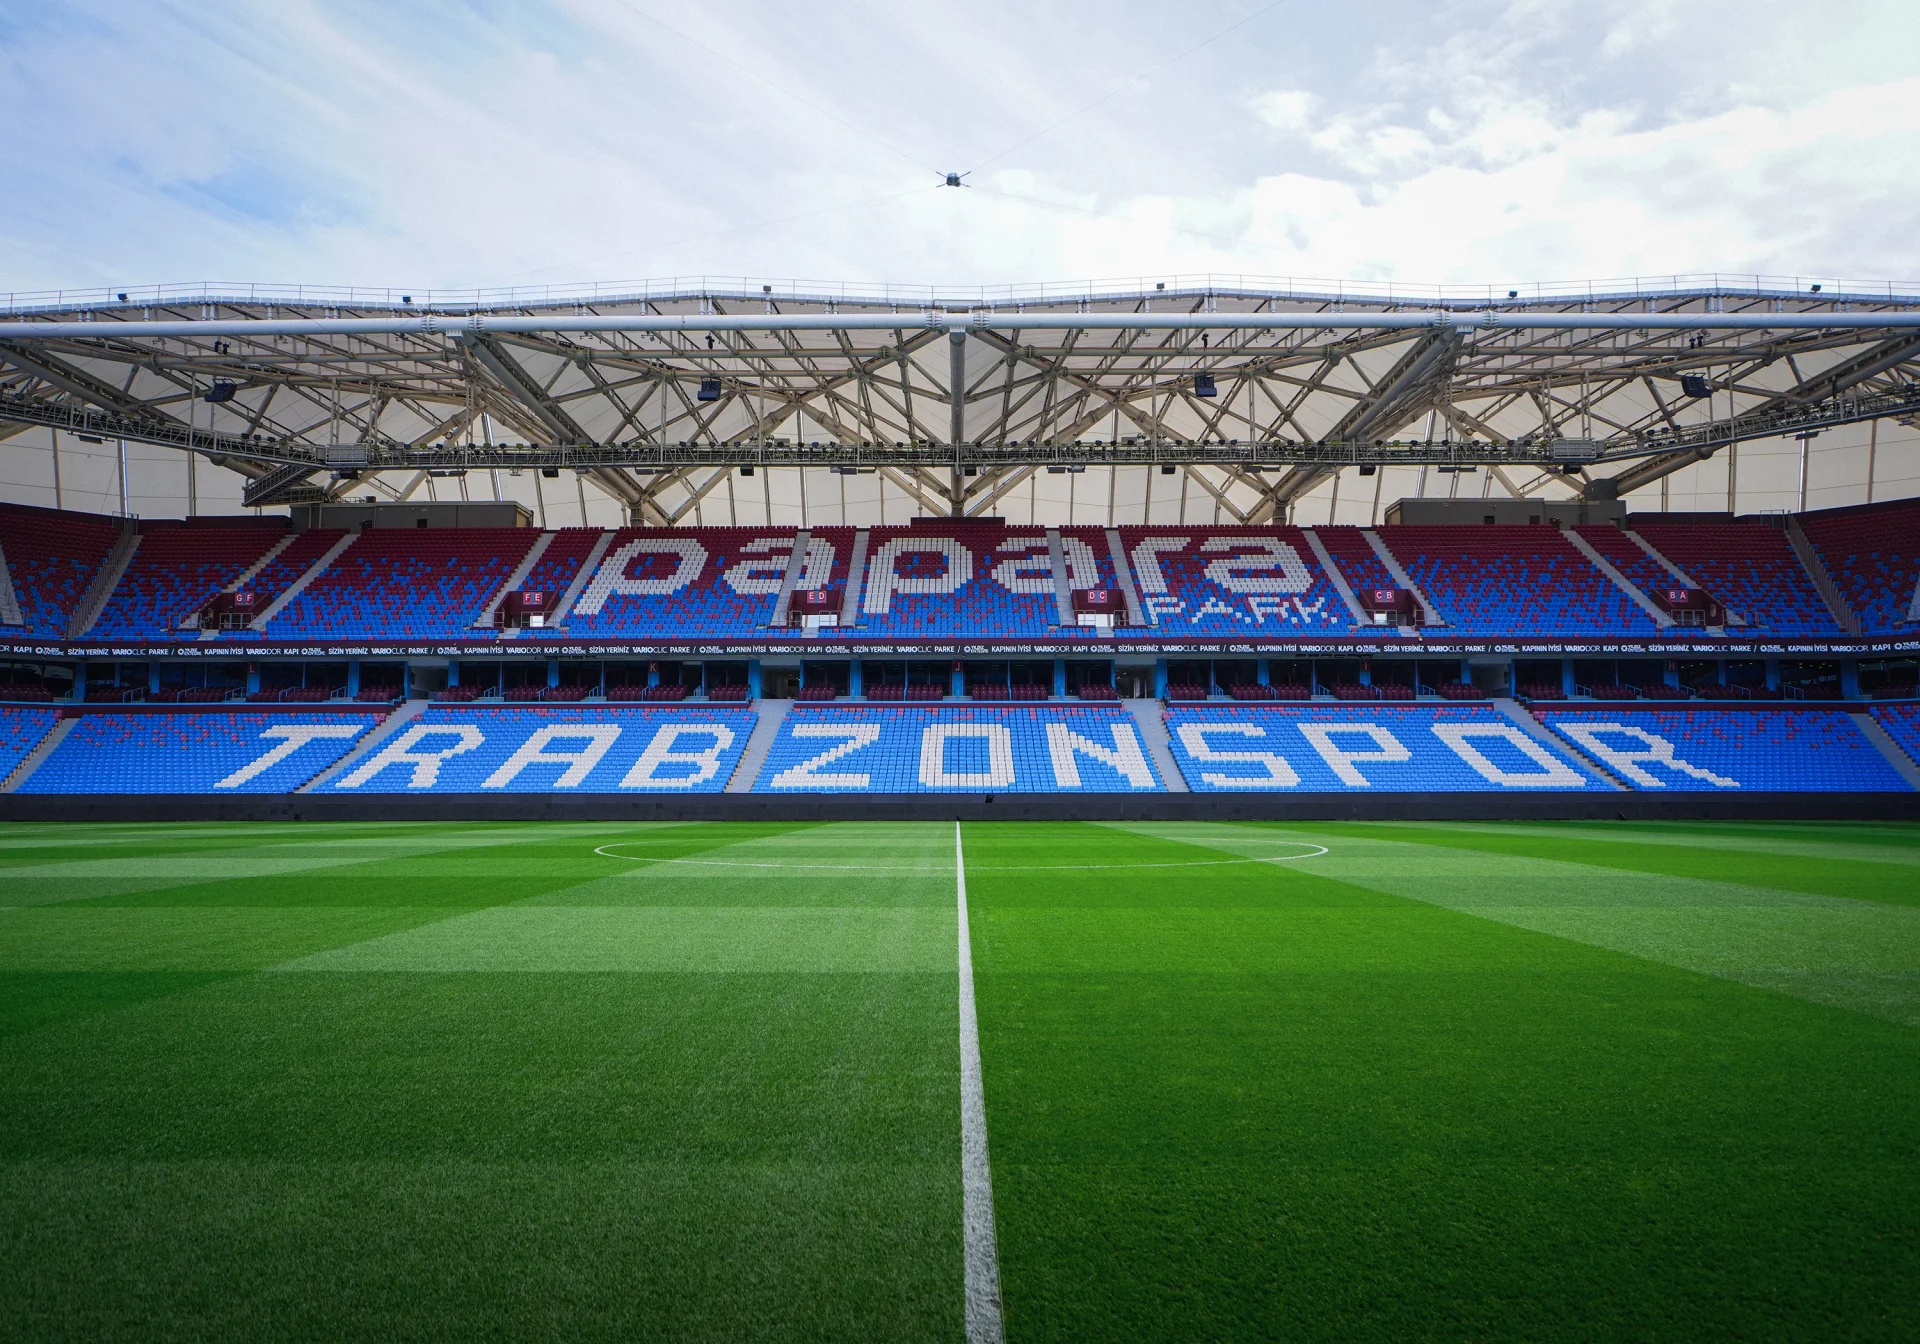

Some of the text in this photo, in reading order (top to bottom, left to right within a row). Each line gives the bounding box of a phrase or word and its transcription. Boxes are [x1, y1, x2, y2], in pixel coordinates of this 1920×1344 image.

[573, 537, 1314, 615] papara
[1145, 597, 1337, 624] PARK
[213, 723, 1741, 788] TRABZONSPOR
